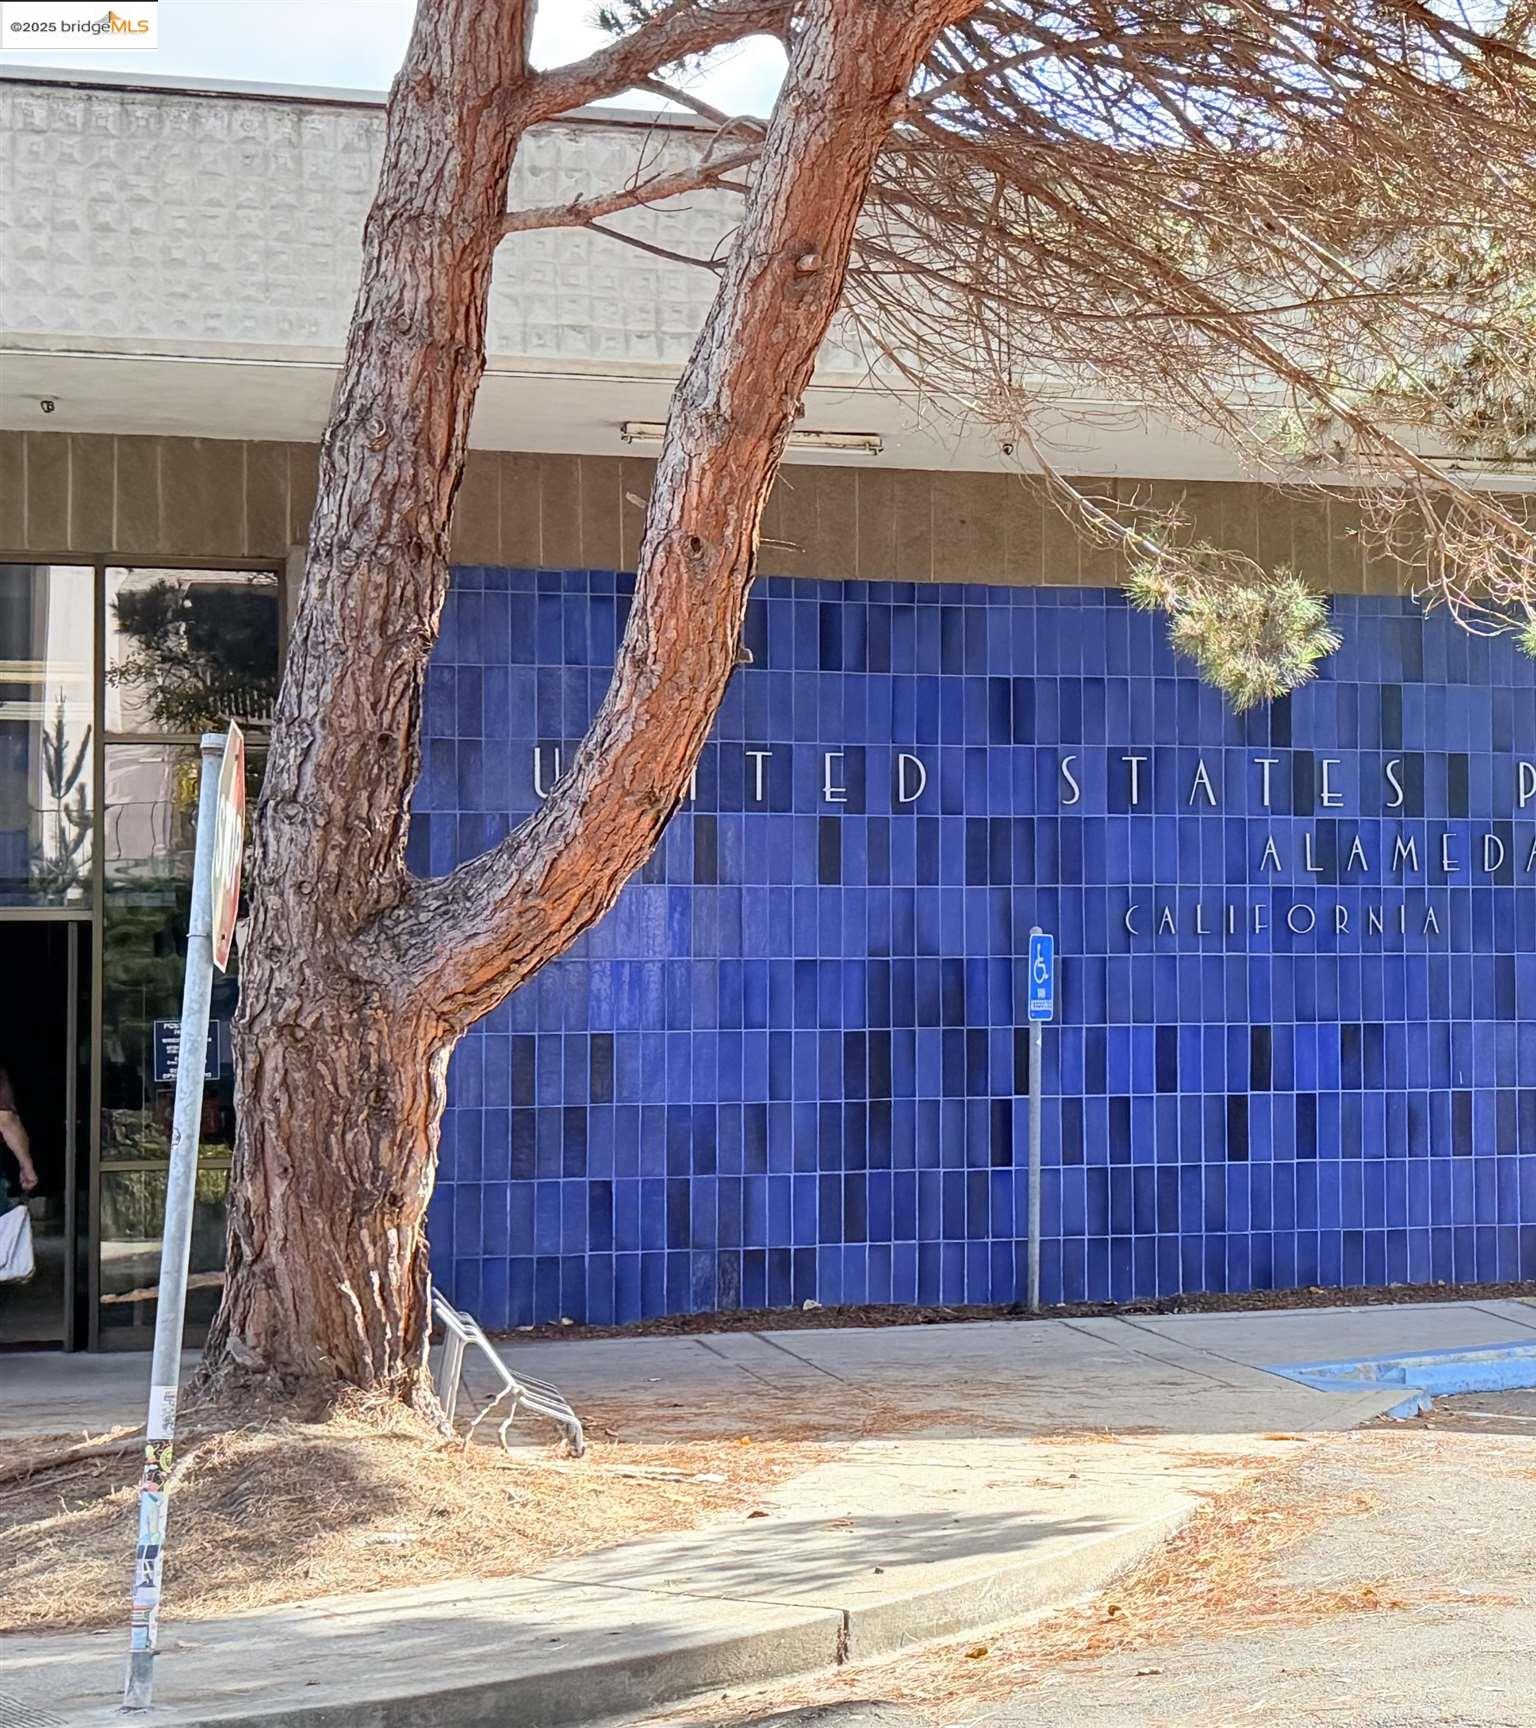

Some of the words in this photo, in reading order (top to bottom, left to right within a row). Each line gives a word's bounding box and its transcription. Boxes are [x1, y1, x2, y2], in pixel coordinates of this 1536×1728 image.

[534, 747, 927, 803] UITED
[1060, 754, 1406, 808] STATES
[1126, 903, 1442, 936] CALIFORNIA
